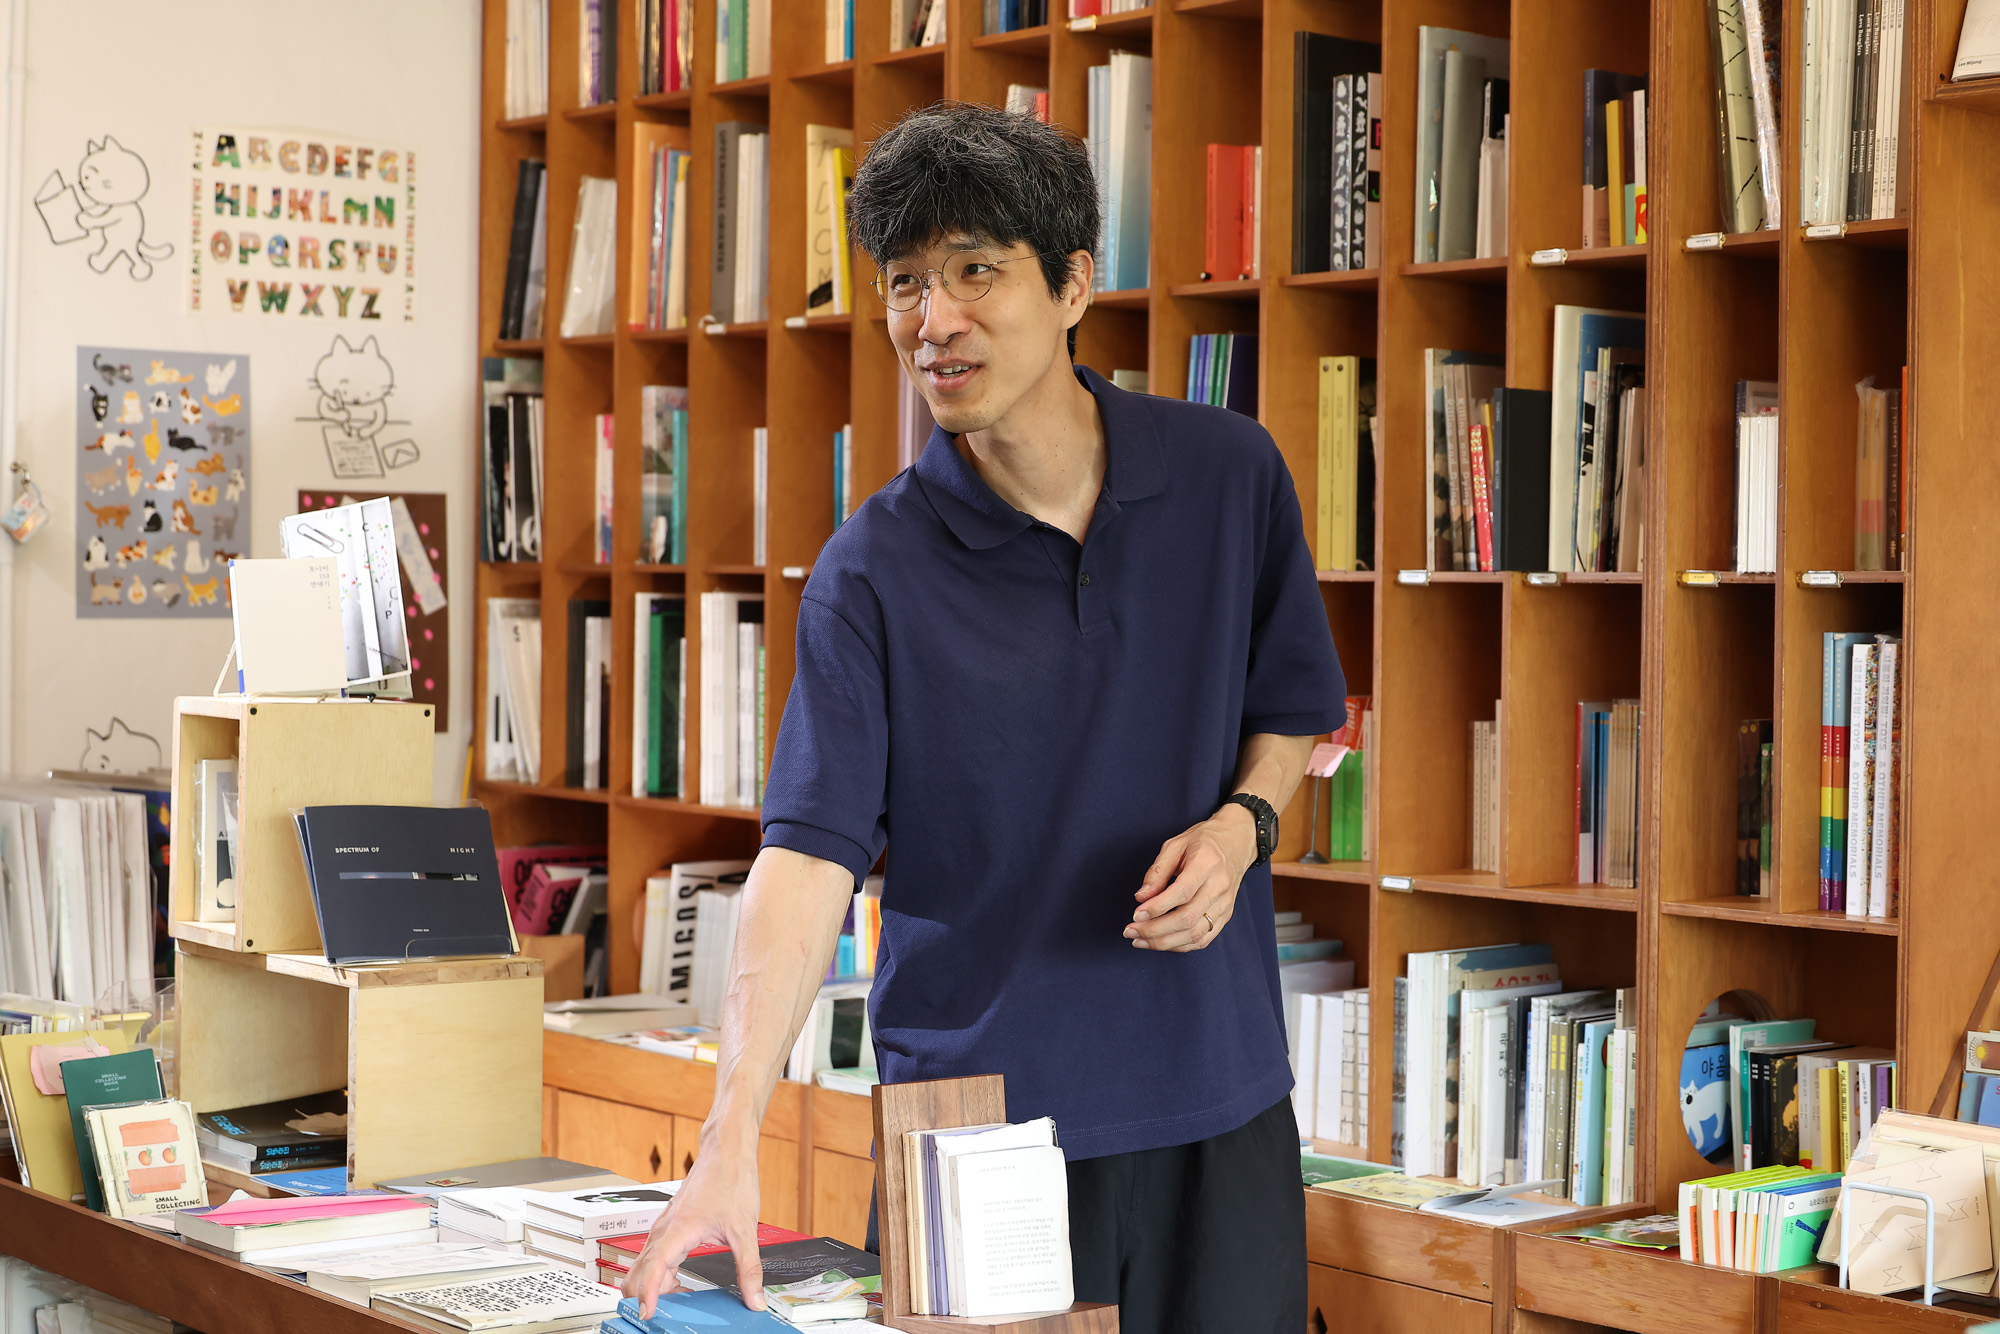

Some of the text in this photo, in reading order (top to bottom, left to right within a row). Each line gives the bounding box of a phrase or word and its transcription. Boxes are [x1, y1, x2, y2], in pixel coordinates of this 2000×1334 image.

[1856, 13, 1865, 56] Love Bunglers
[1864, 28, 1872, 55] Bunglers
[1872, 11, 1881, 55] Love Bunglers
[716, 130, 727, 273] UPPERHOUSE ORIENTED
[1446, 398, 1459, 507] Killing and Dying
[1457, 398, 1473, 507] Killing and Dying
[1852, 721, 1861, 751] TOYS
[1879, 721, 1888, 751] TOYS
[1851, 772, 1860, 809] OTHER
[1876, 772, 1886, 809] OTHER
[1849, 812, 1859, 878] MEMORIALS
[1874, 812, 1885, 879] MEMORIALS
[94, 1075, 127, 1084] COLLECTING
[1701, 1054, 1726, 1078] 야옹
[156, 1198, 201, 1210] COLLECTING
[599, 1220, 616, 1231] 배움의
[617, 1219, 628, 1229] 배신
